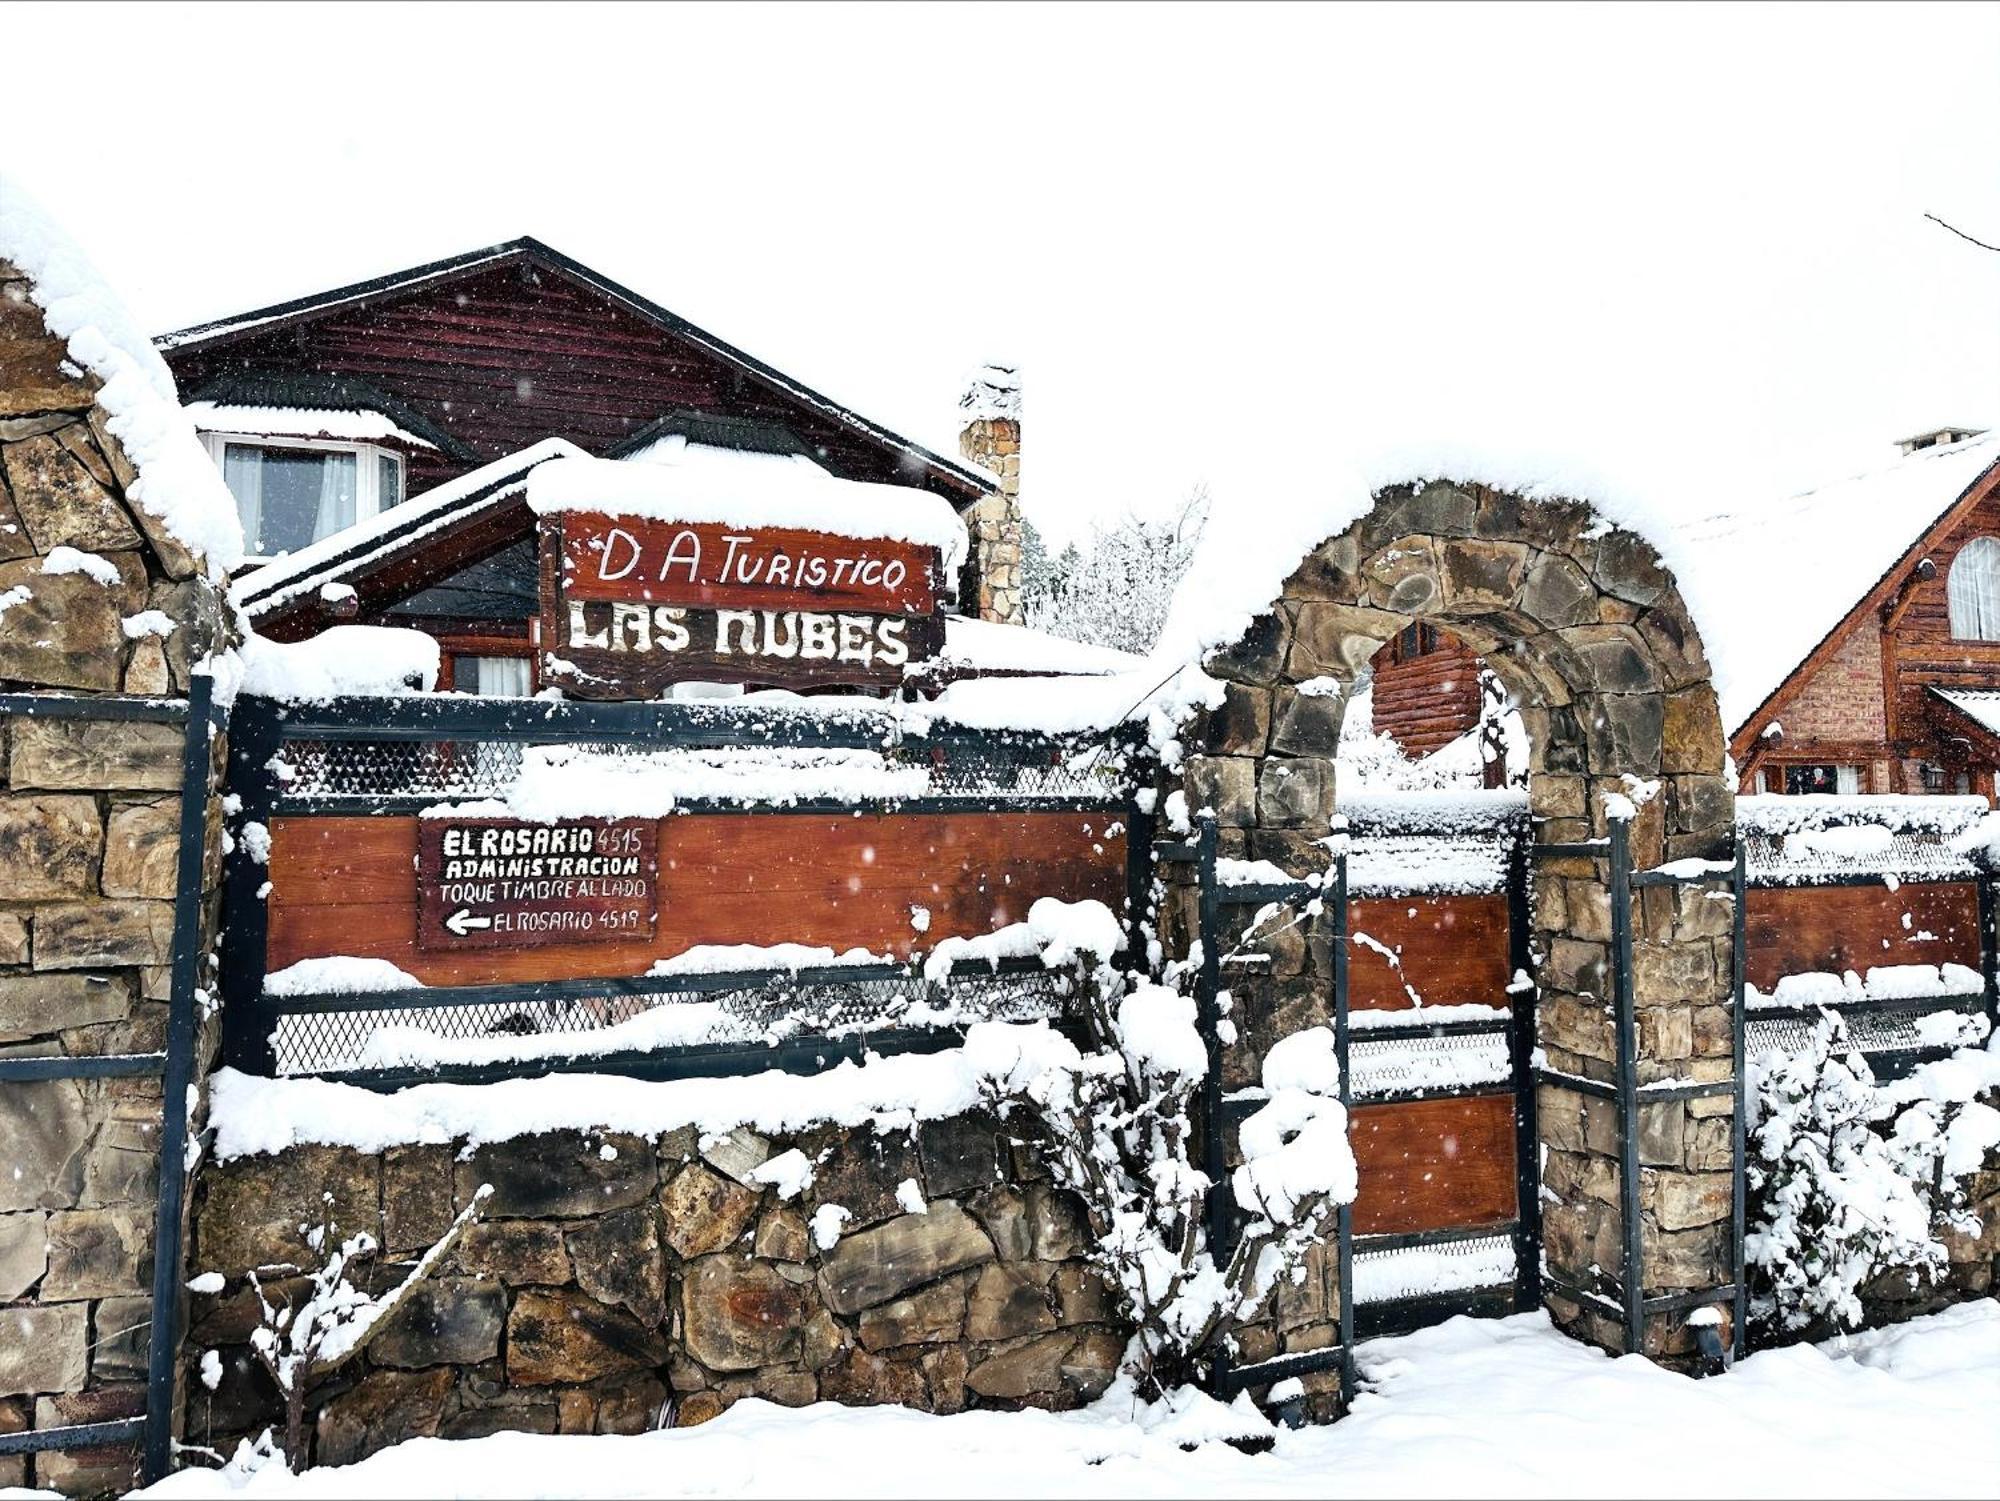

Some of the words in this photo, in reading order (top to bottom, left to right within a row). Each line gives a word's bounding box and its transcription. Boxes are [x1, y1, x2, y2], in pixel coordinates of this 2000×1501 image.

[719, 535, 906, 588] TURISTICO
[568, 600, 690, 653] LAS
[715, 609, 909, 667] NUBES
[442, 829, 476, 856] EL
[480, 828, 593, 856] ROSARIO
[597, 827, 644, 852] 4515
[446, 856, 639, 879] ADMINISTRACION
[440, 882, 495, 904] TOQUE
[501, 880, 575, 900] TIMBRE
[576, 880, 598, 898] AL
[601, 879, 646, 898] LADO
[494, 913, 513, 933] EL
[516, 911, 593, 931] ROSARIO
[598, 910, 639, 929] 4519
